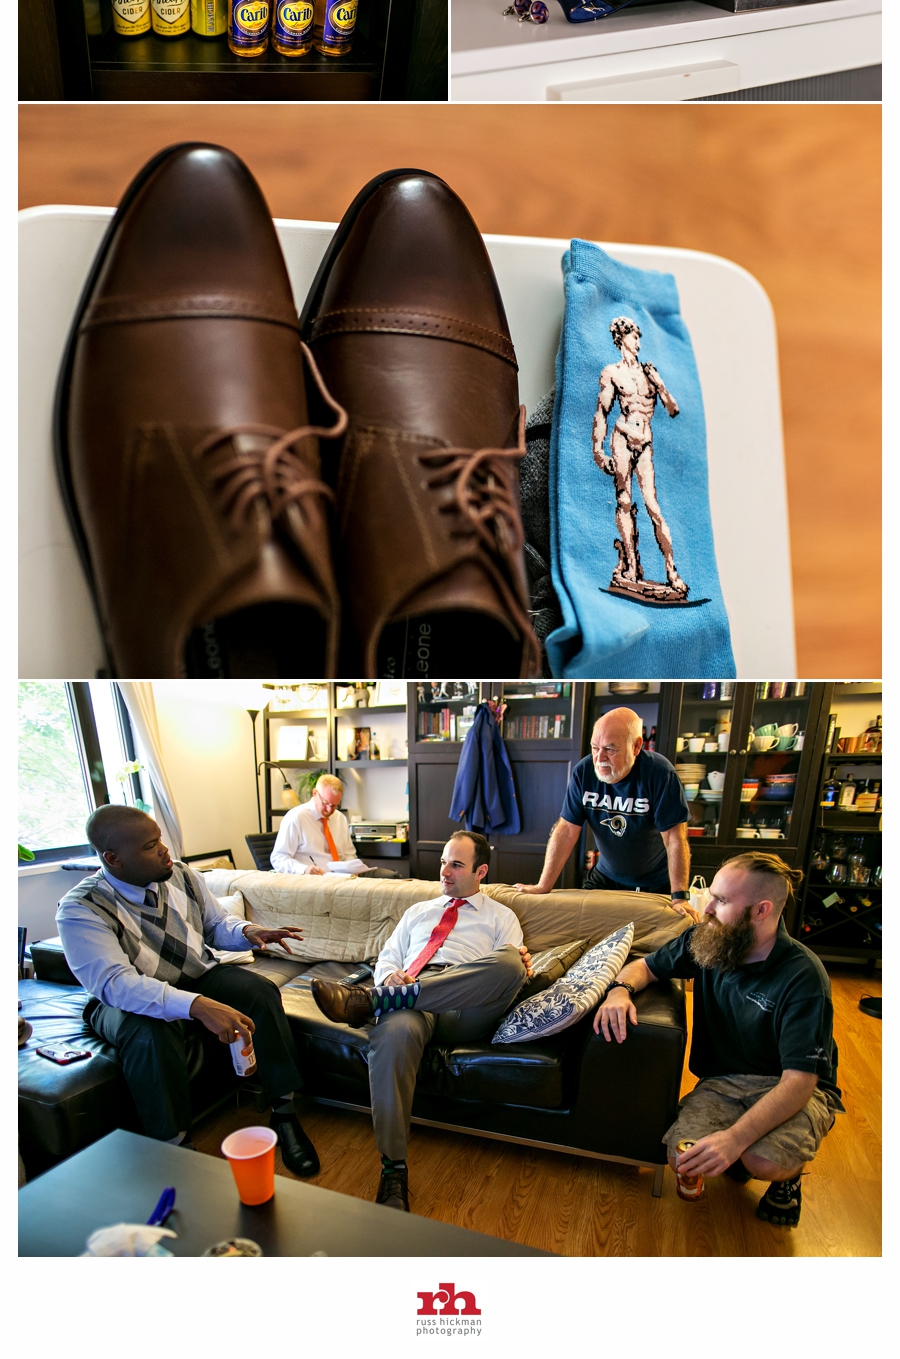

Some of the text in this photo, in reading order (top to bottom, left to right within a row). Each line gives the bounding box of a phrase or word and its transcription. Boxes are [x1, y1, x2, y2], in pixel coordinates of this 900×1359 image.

[122, 6, 143, 15] CIDER
[160, 6, 181, 15] CIDER
[240, 6, 268, 21] Carib
[283, 7, 312, 21] Carib
[582, 791, 650, 813] RAMS
